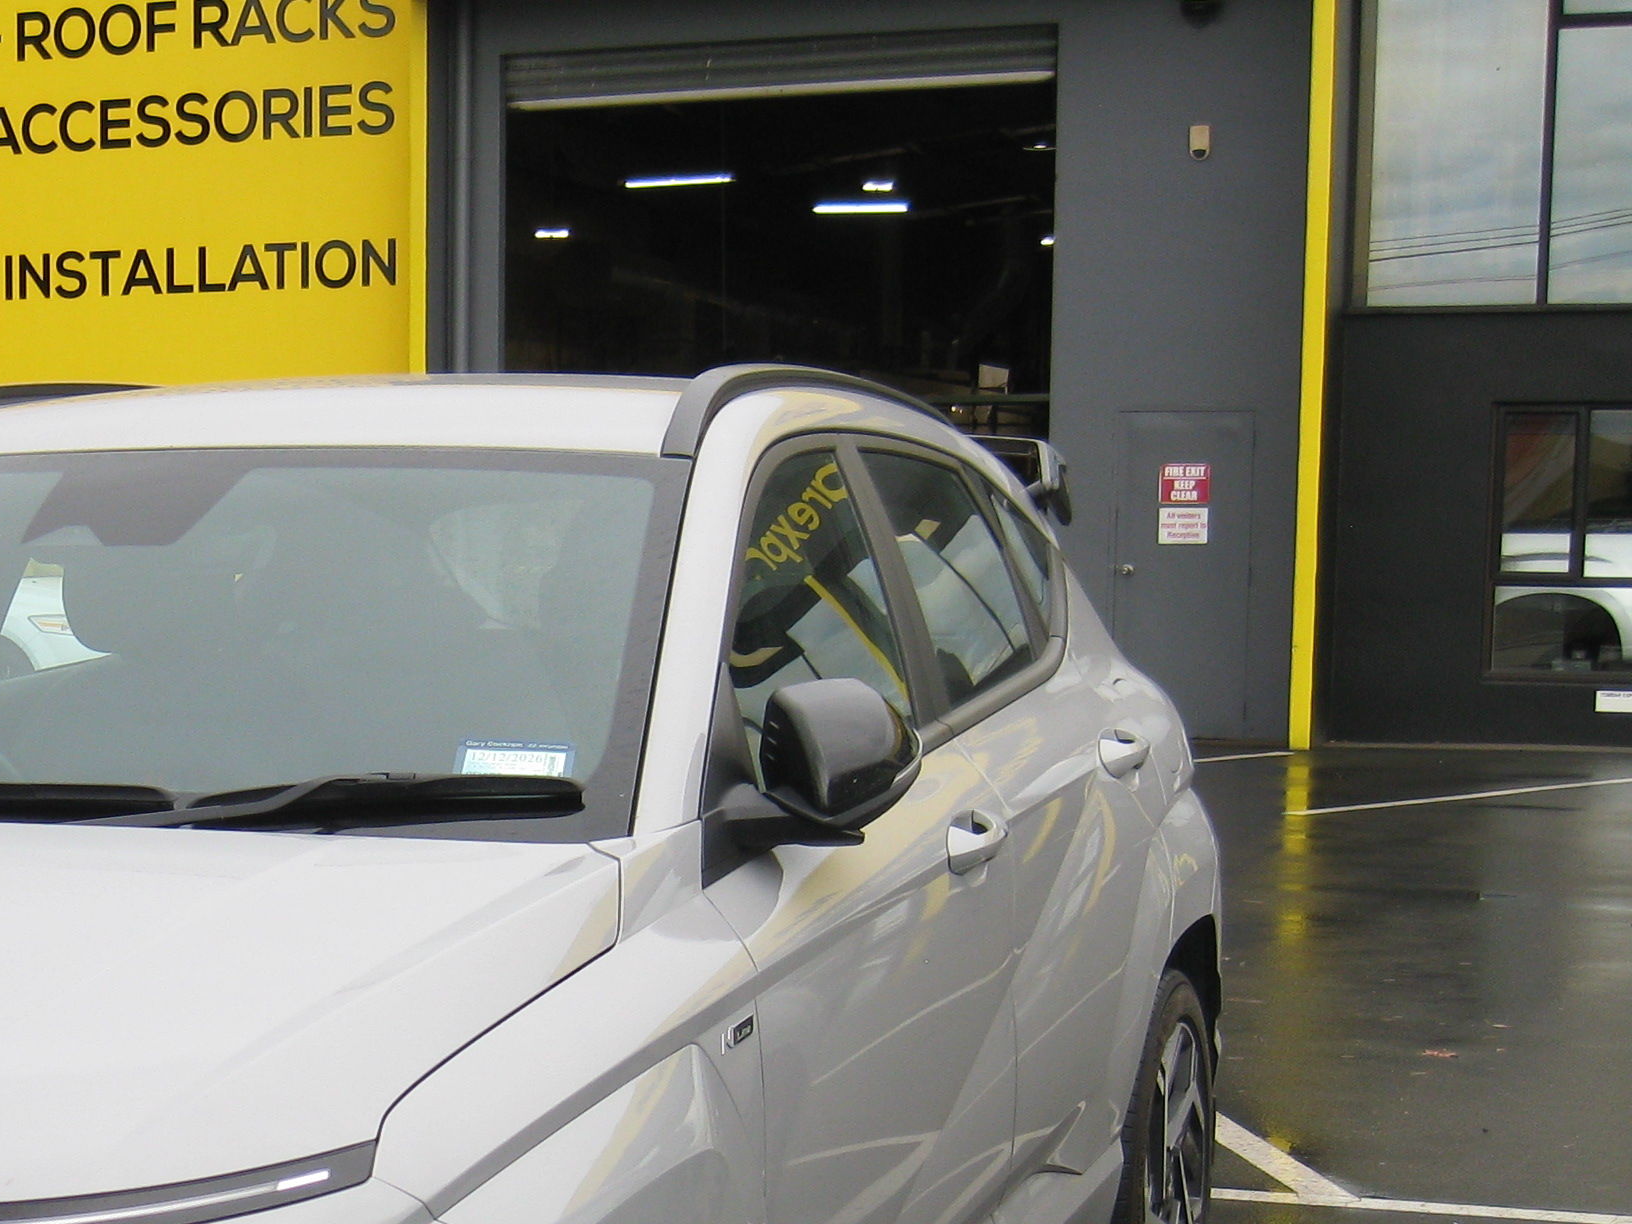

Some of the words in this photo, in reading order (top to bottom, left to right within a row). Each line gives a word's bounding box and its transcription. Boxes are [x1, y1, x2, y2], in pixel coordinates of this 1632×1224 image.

[16, 2, 178, 62] ROOF
[192, 0, 397, 49] RACKS
[4, 237, 398, 301] INSTALLATION
[1164, 466, 1184, 477] FIRE
[1185, 466, 1206, 477] EXIT
[1173, 480, 1196, 490] KEEP
[1170, 490, 1198, 501] CLEAR
